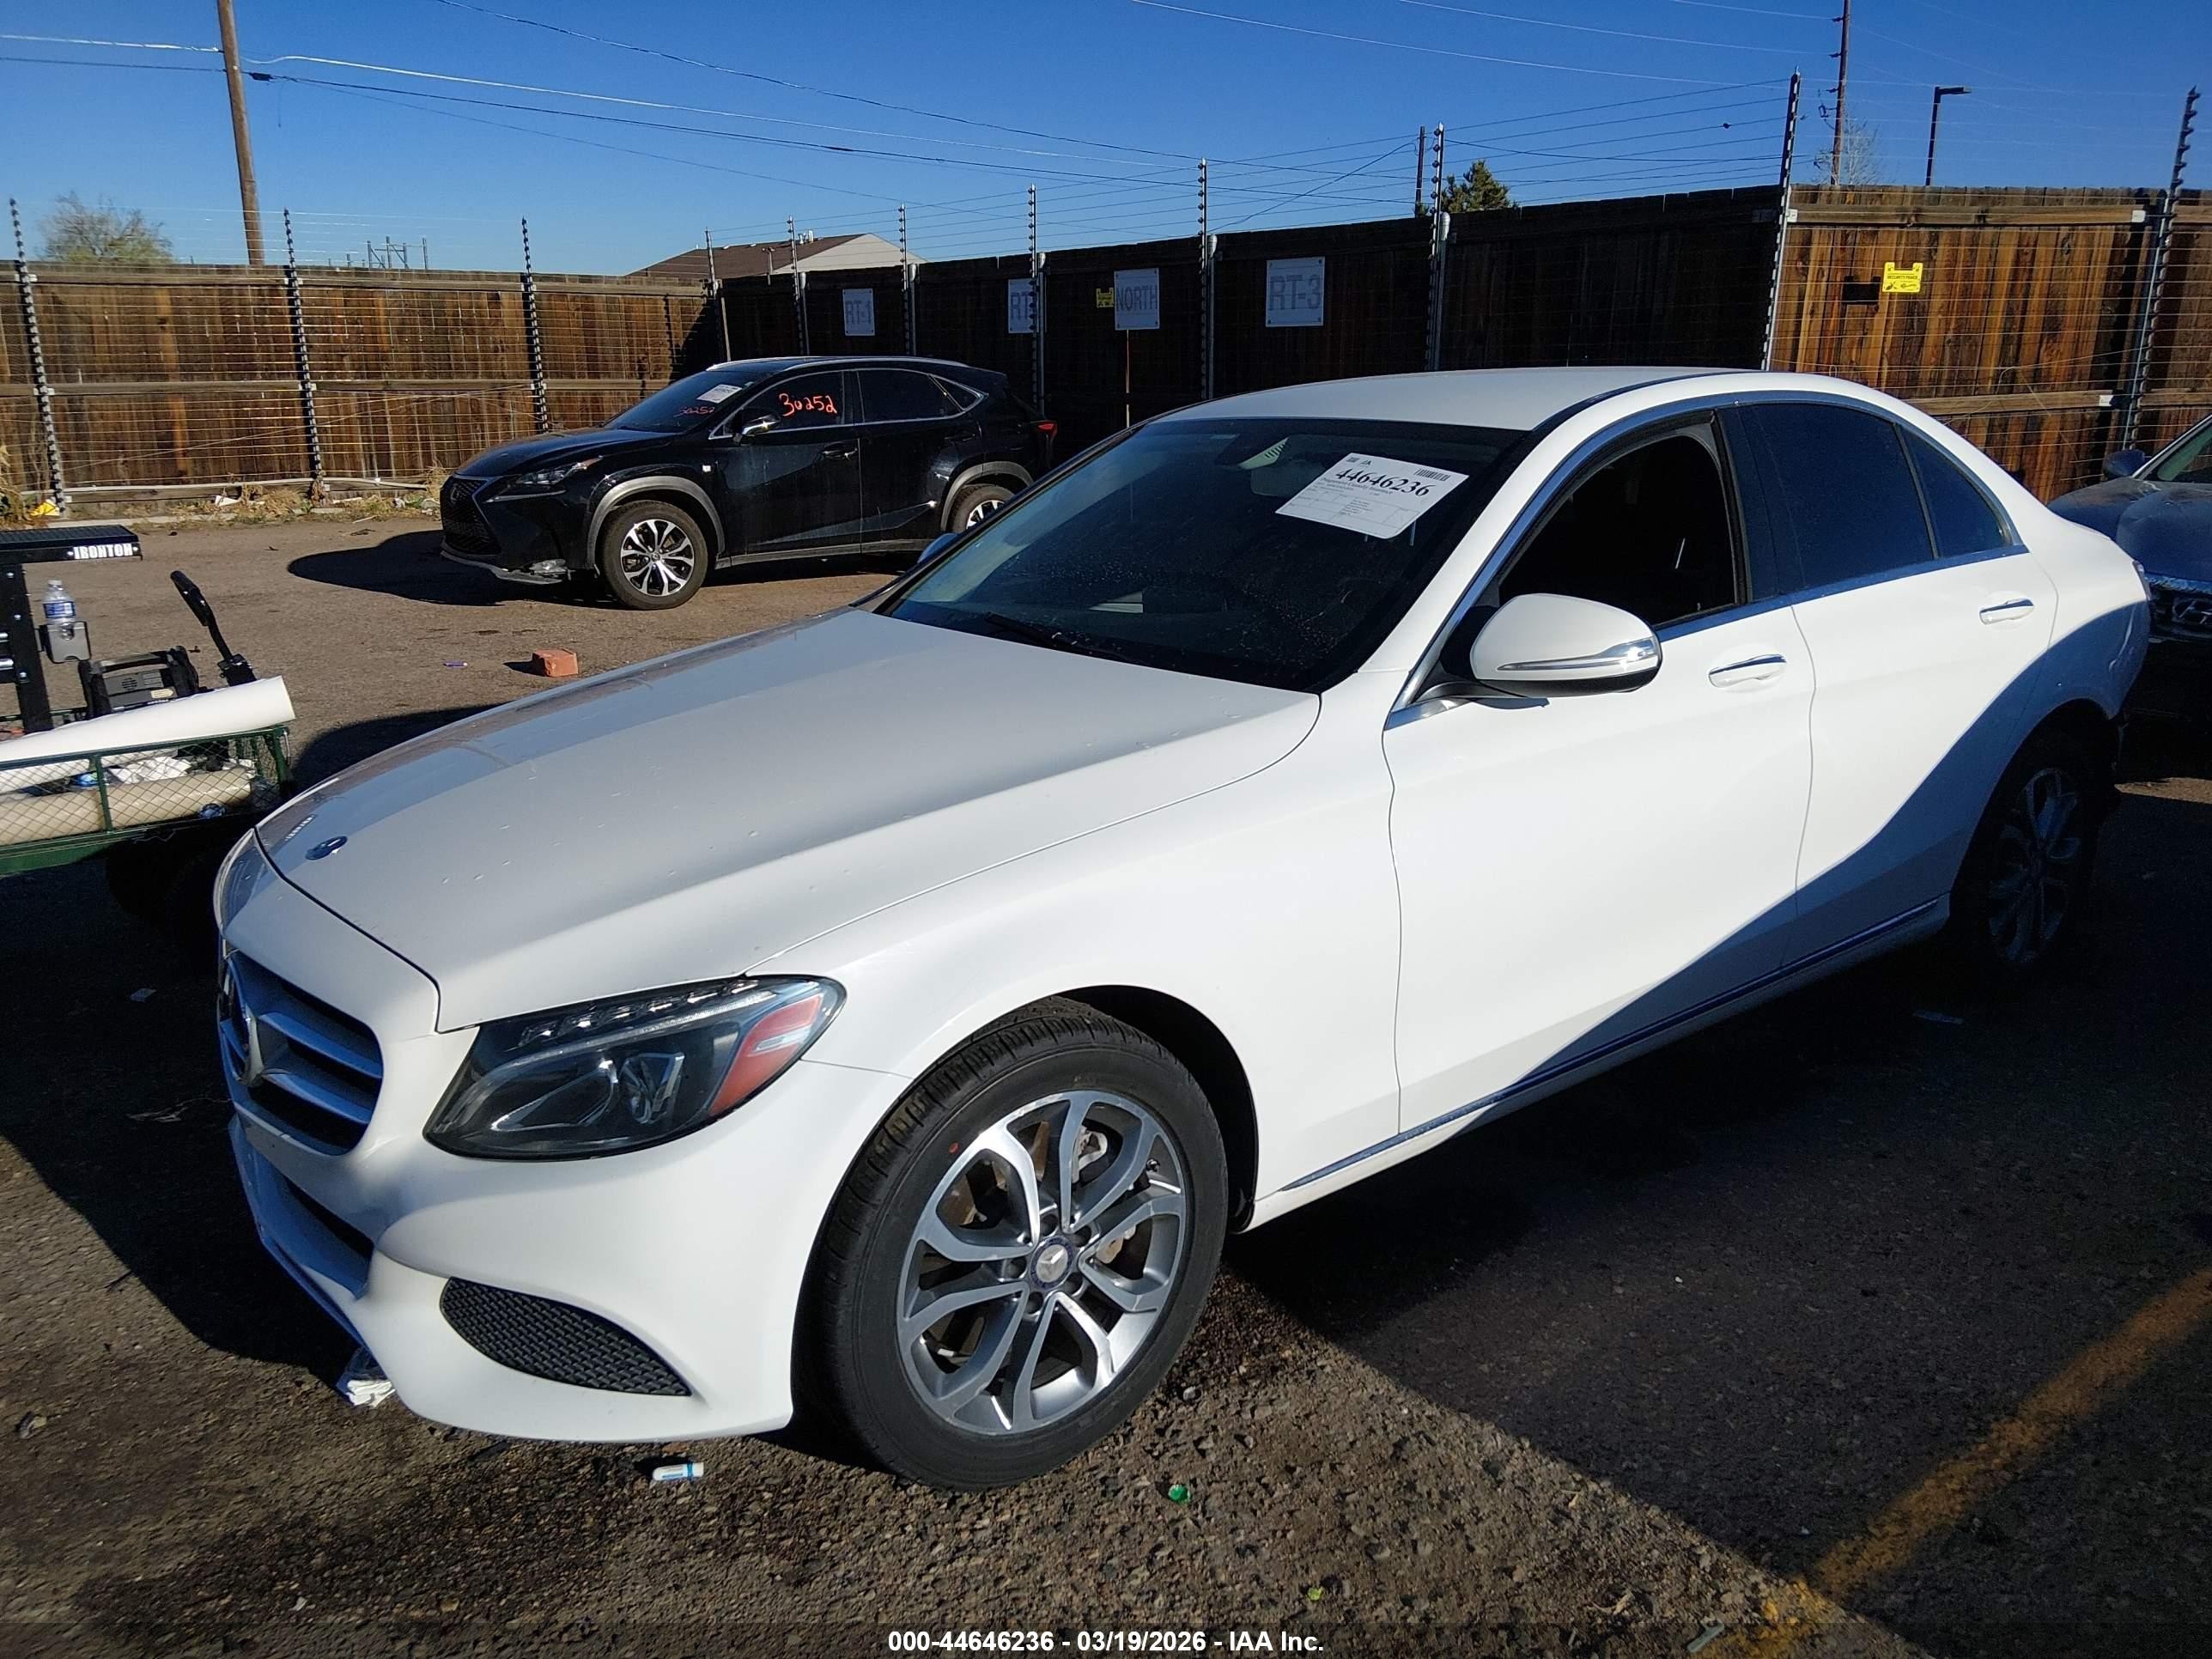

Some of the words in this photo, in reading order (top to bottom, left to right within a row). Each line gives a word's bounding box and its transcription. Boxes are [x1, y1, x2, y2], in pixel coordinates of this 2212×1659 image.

[1116, 285, 1158, 311] NORTH
[1269, 274, 1322, 310] RT-3
[1010, 292, 1034, 320] RT
[779, 392, 838, 416] 30252
[1334, 468, 1436, 496] 44646236
[73, 543, 133, 560] IRONTON
